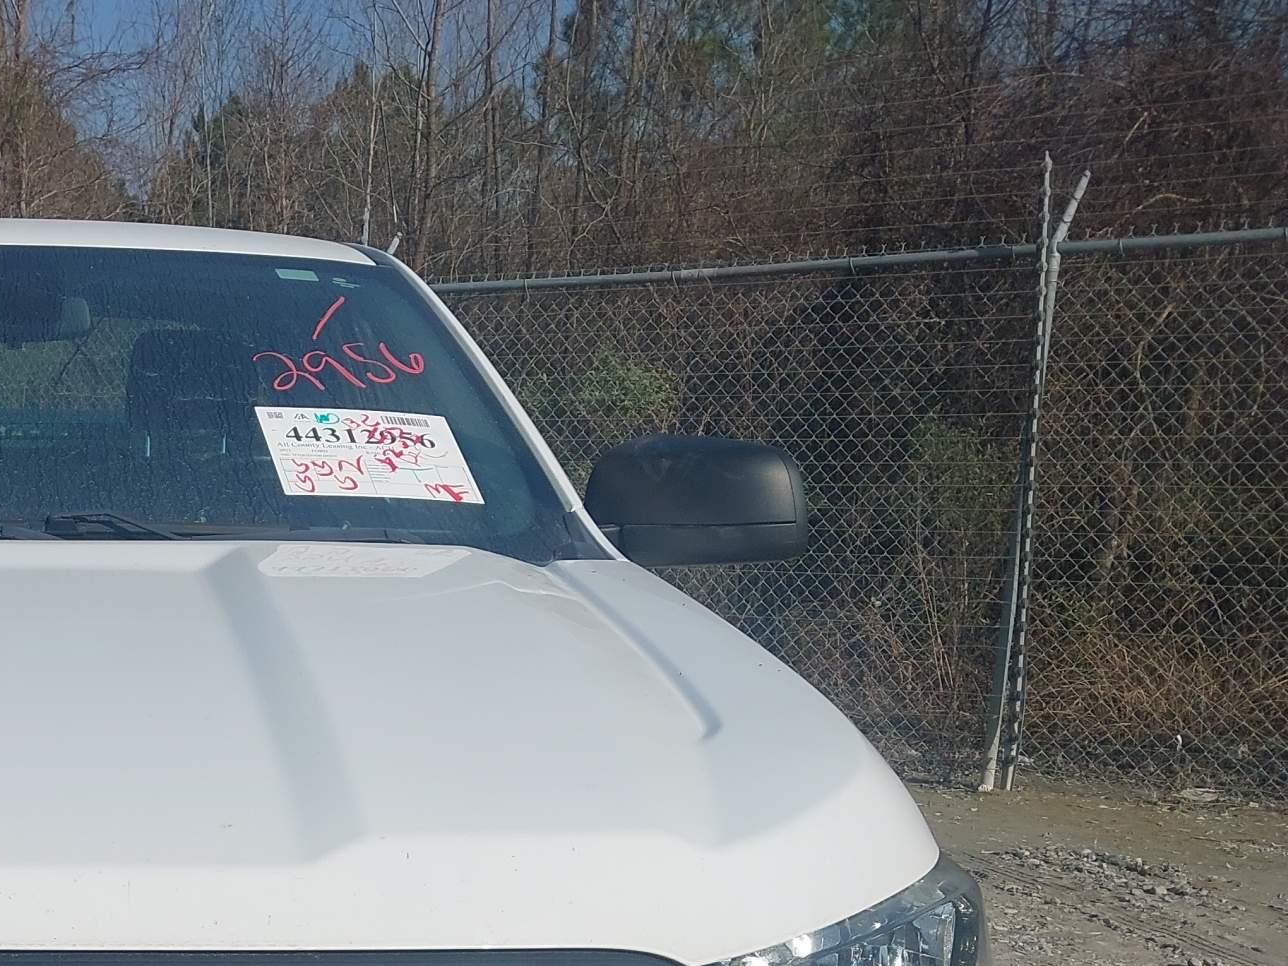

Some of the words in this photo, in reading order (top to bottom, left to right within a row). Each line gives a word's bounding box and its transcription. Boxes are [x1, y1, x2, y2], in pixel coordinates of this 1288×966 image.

[252, 342, 425, 391] 2956
[285, 426, 436, 449] 44312956
[291, 442, 320, 450] County
